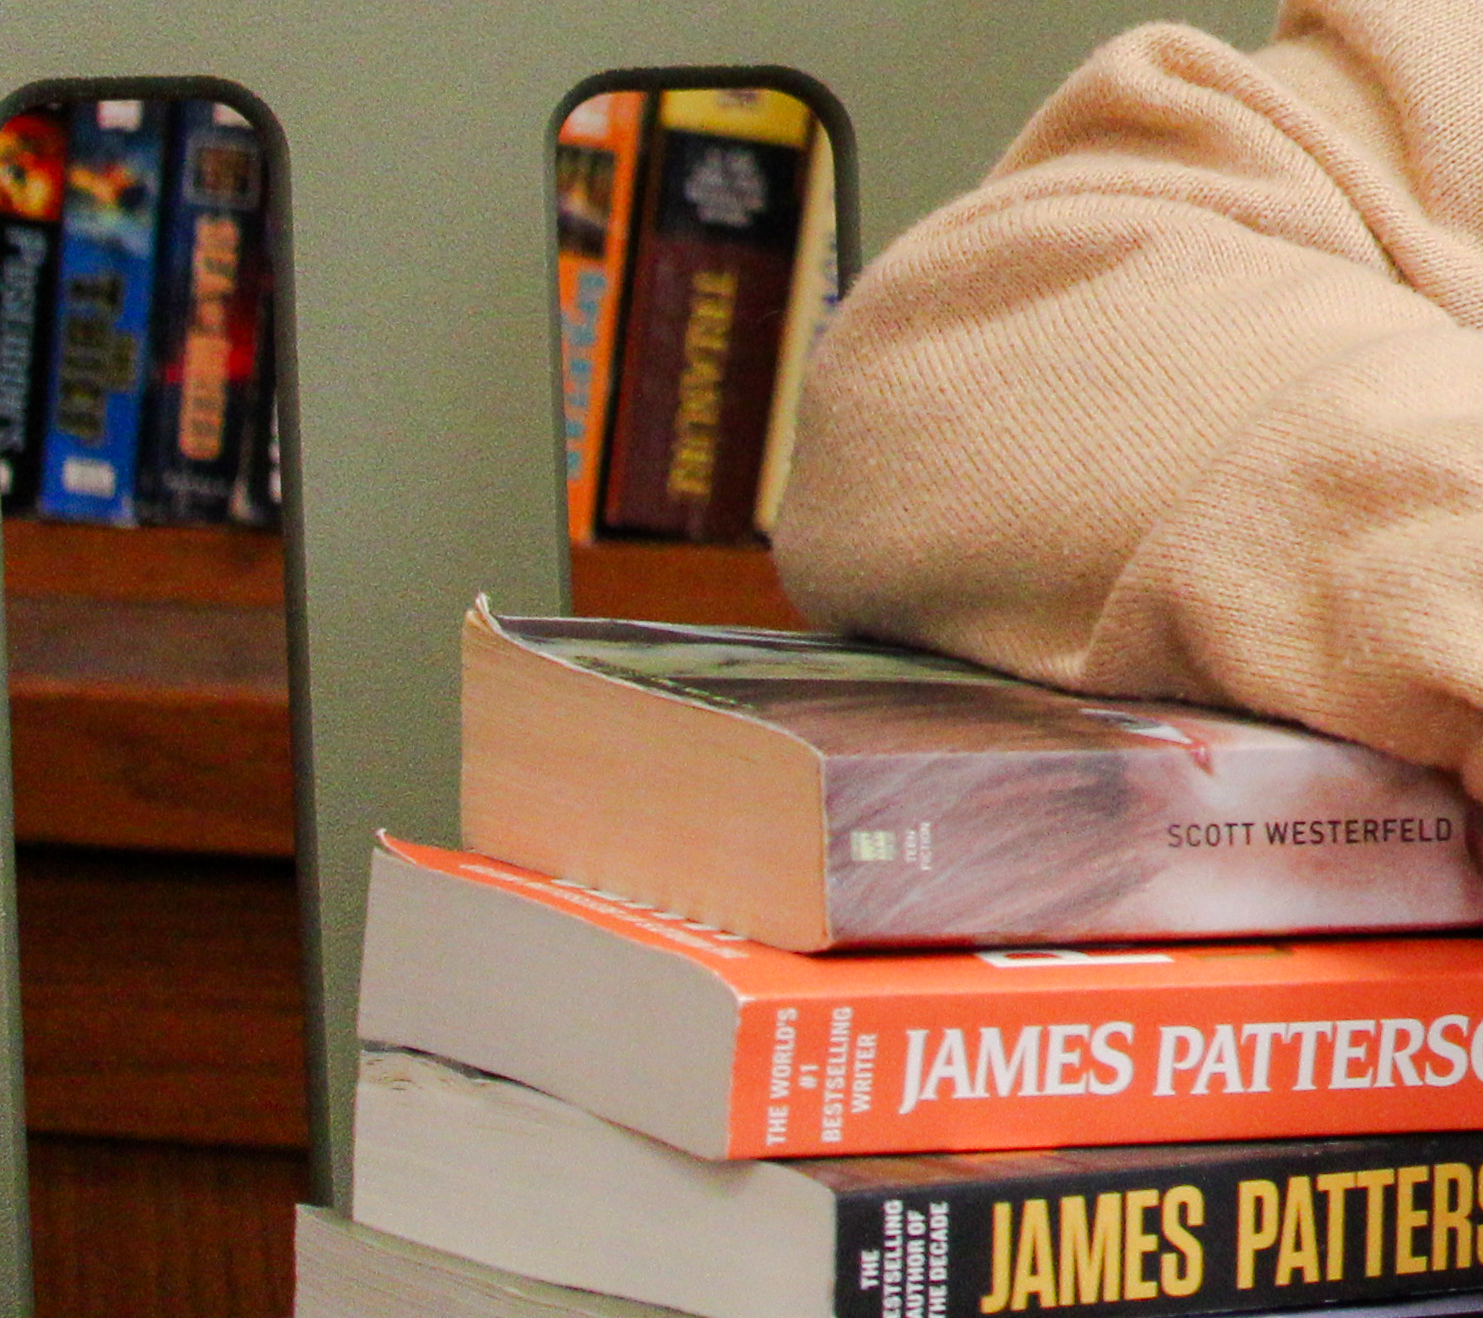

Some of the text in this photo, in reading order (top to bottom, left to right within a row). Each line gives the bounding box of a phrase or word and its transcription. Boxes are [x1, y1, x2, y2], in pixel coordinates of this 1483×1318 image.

[1166, 820, 1255, 851] SCOTT
[1263, 817, 1452, 847] WESTERFELD
[765, 1005, 799, 1147] THE WORLD'S
[799, 1062, 820, 1091] #1
[821, 1005, 853, 1144] BESTSELLING
[850, 1032, 878, 1114] WRITER
[898, 1020, 1136, 1115] JAMES
[907, 1210, 928, 1237] OF
[929, 1201, 951, 1277] DECADE
[979, 1181, 1206, 1316] JAMES
[859, 1249, 881, 1291] THE
